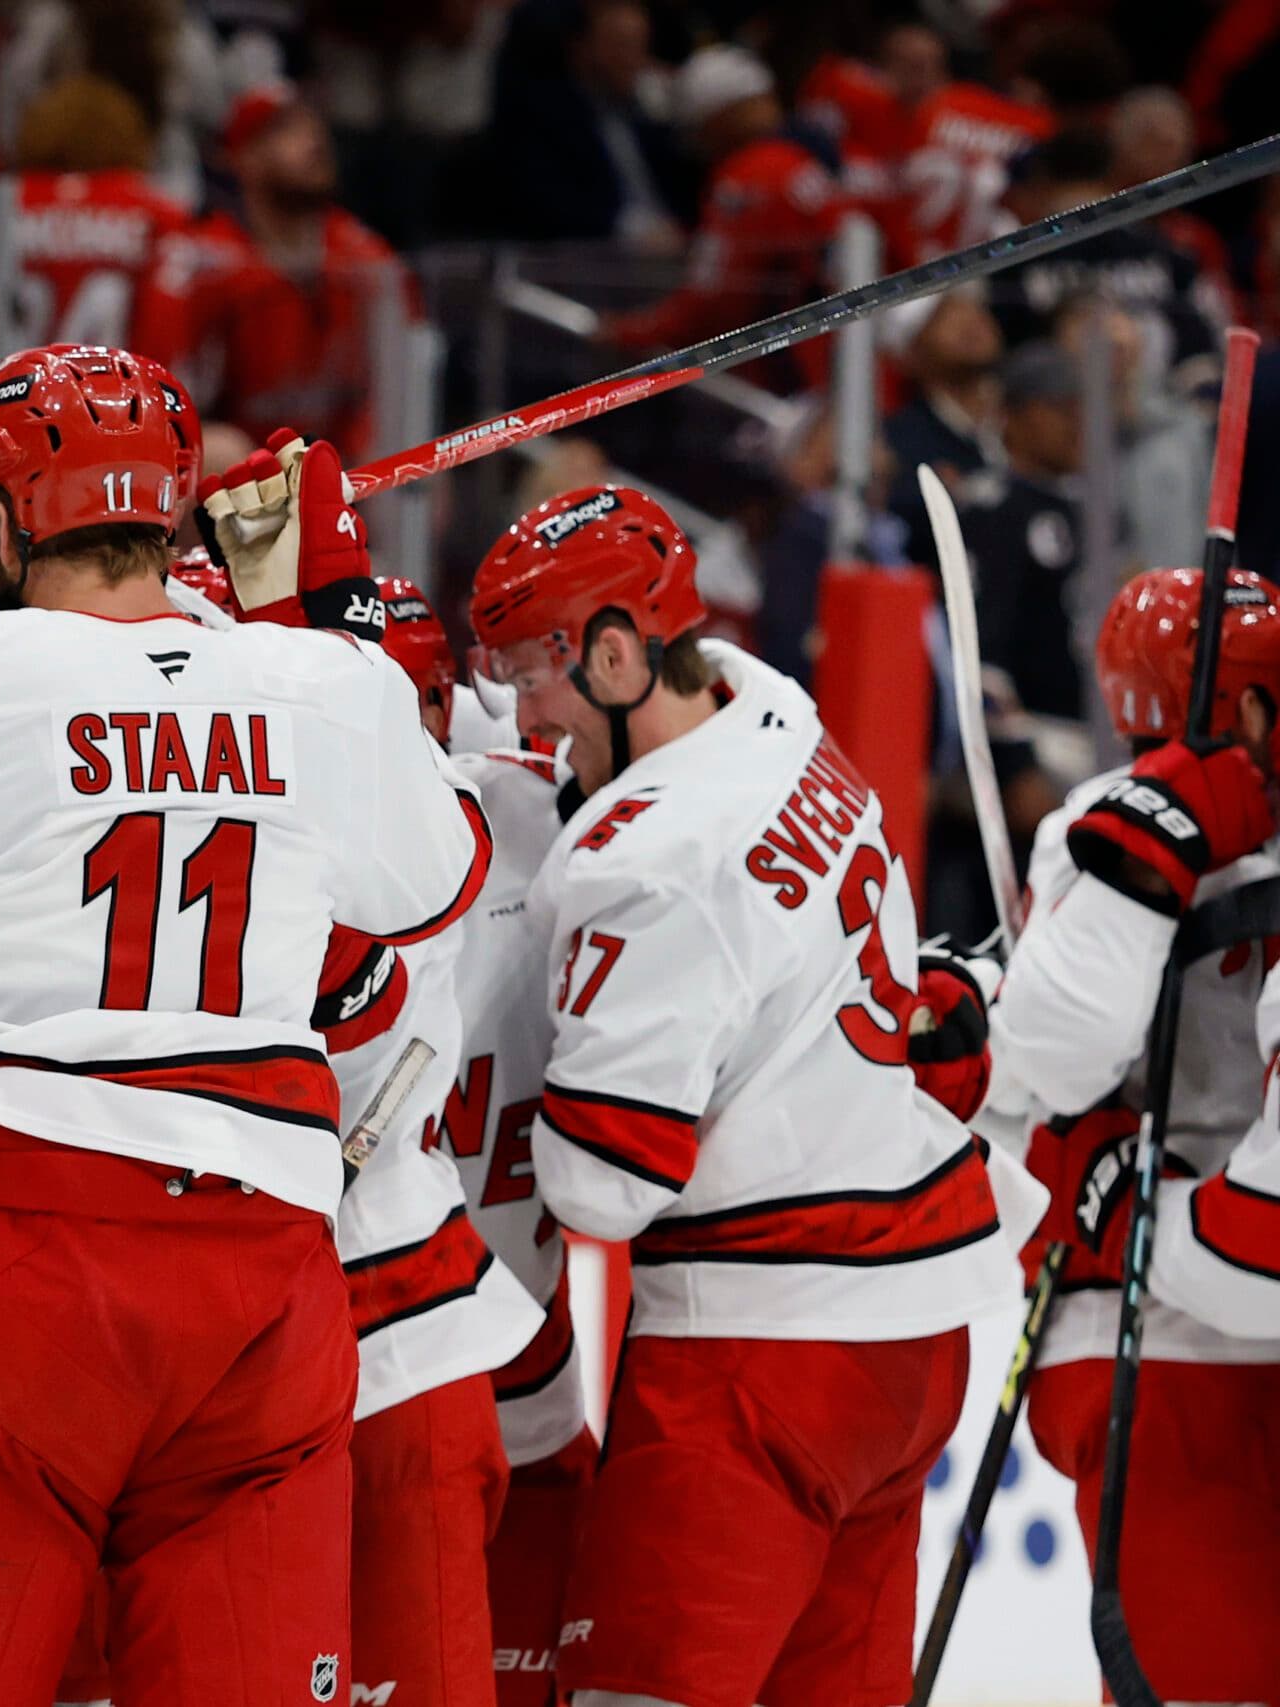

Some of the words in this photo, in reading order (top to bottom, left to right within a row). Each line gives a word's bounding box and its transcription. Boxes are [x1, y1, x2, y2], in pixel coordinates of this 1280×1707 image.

[102, 472, 133, 513] 11
[544, 493, 615, 541] Lenovo
[67, 712, 286, 795] STAAL
[746, 736, 869, 910] SVECH
[82, 811, 258, 1017] 11
